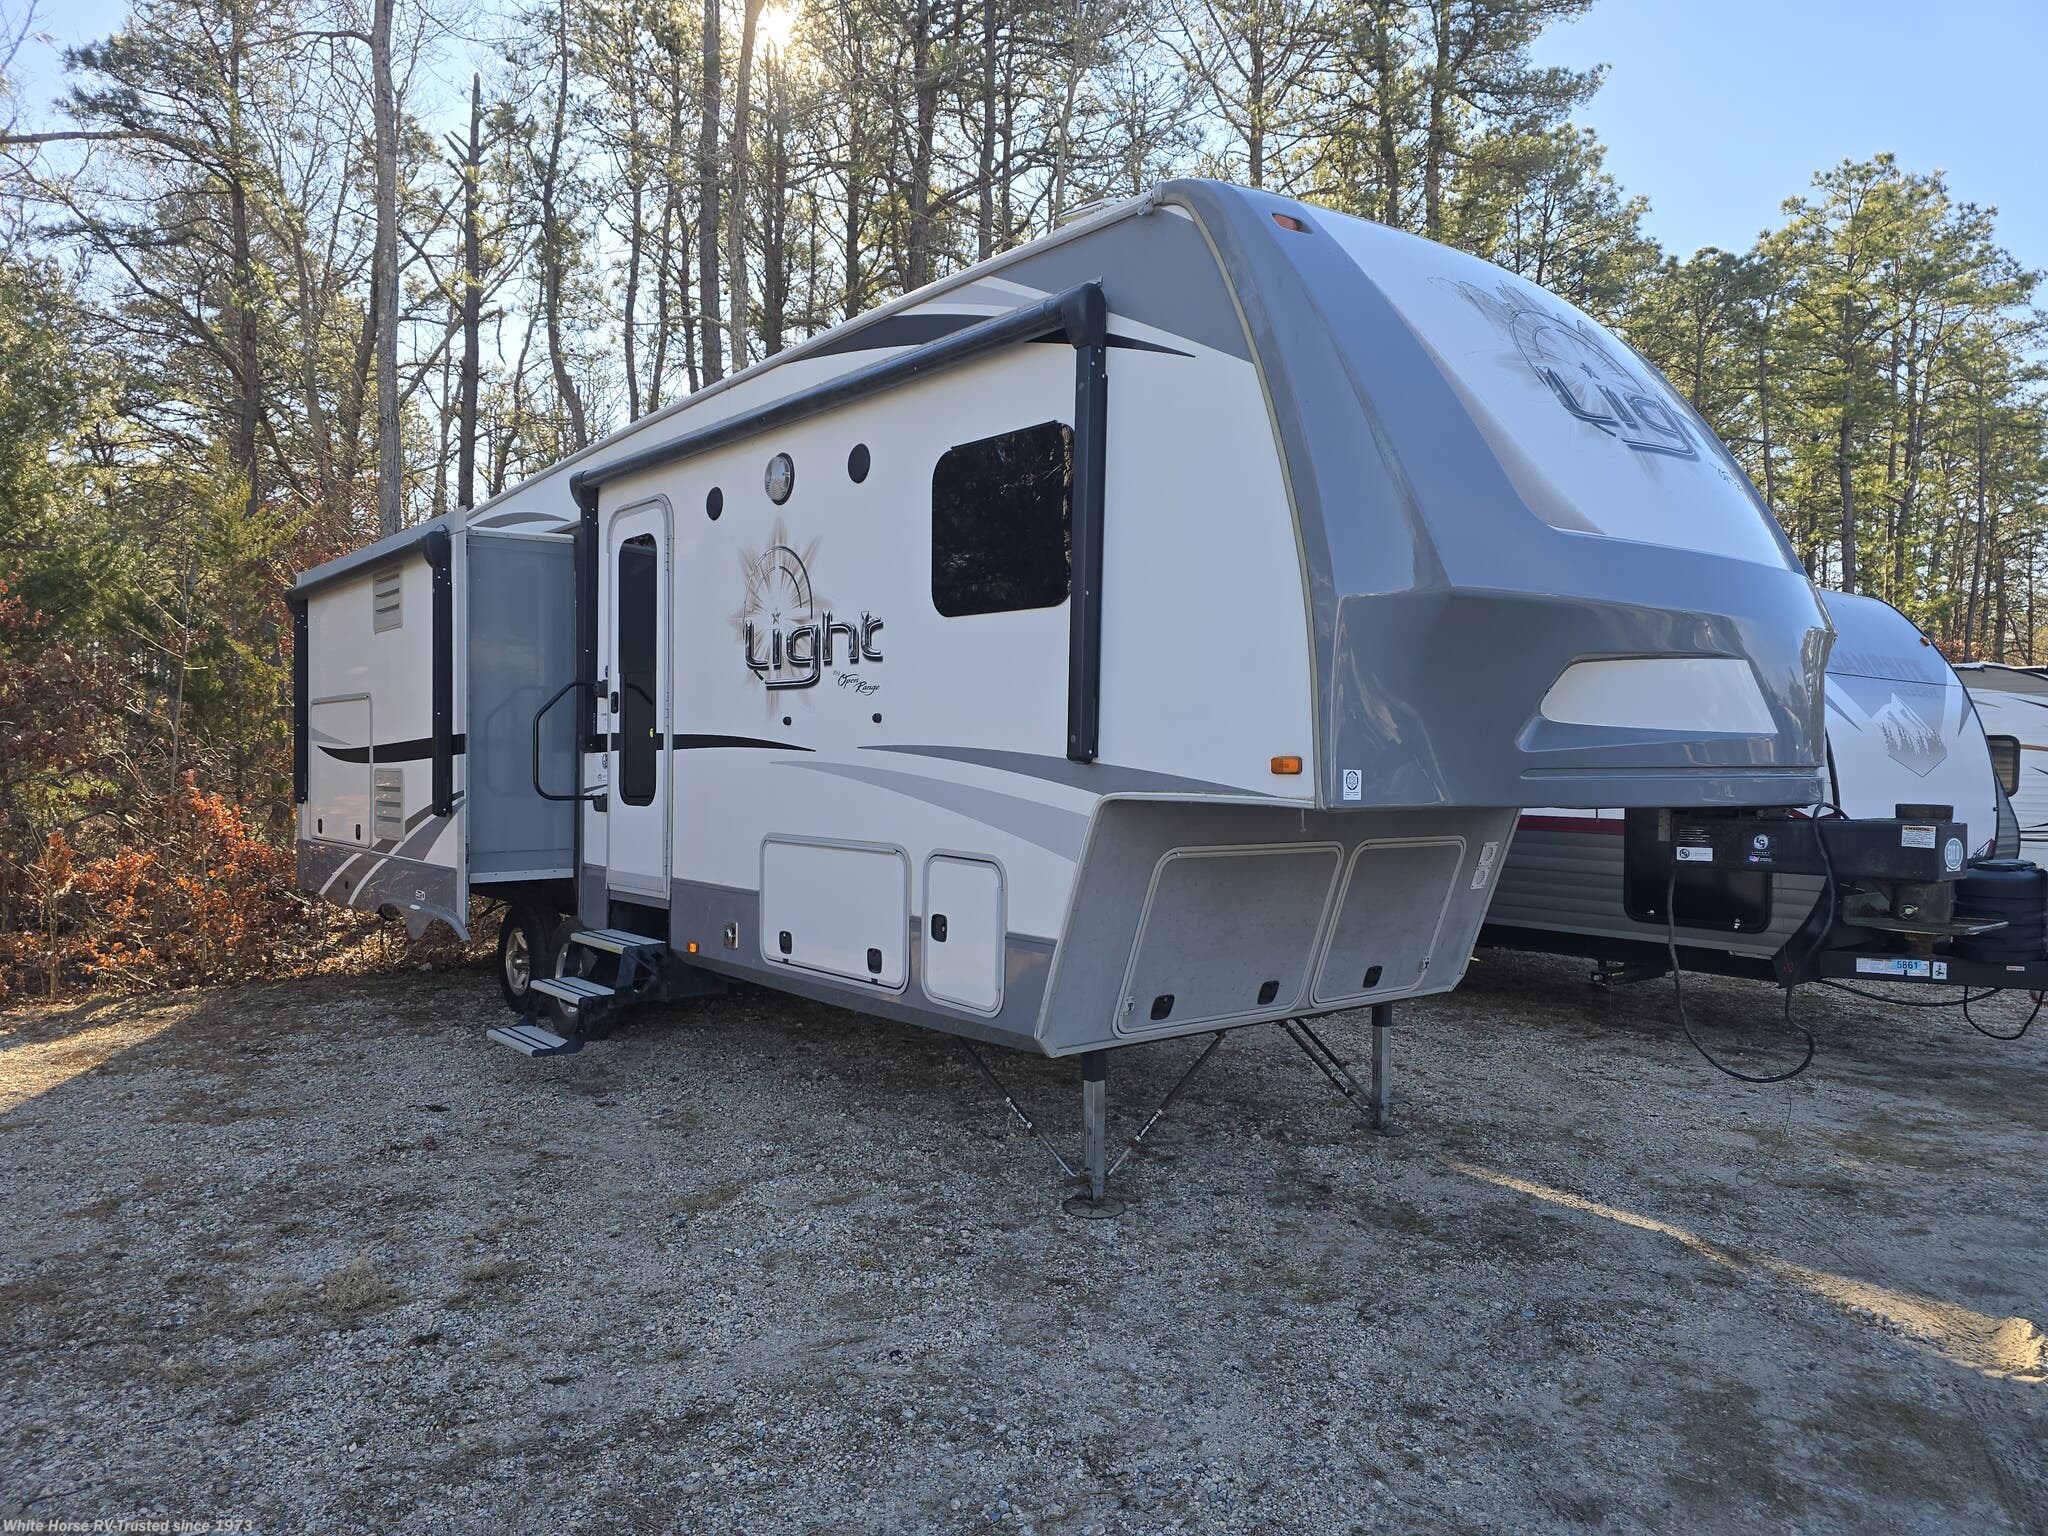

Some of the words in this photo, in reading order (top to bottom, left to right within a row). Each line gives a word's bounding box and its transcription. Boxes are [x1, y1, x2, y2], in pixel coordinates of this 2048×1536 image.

[744, 609, 884, 690] Light
[838, 673, 860, 689] Open
[853, 681, 880, 696] Range
[1896, 960, 1918, 970] 5861
